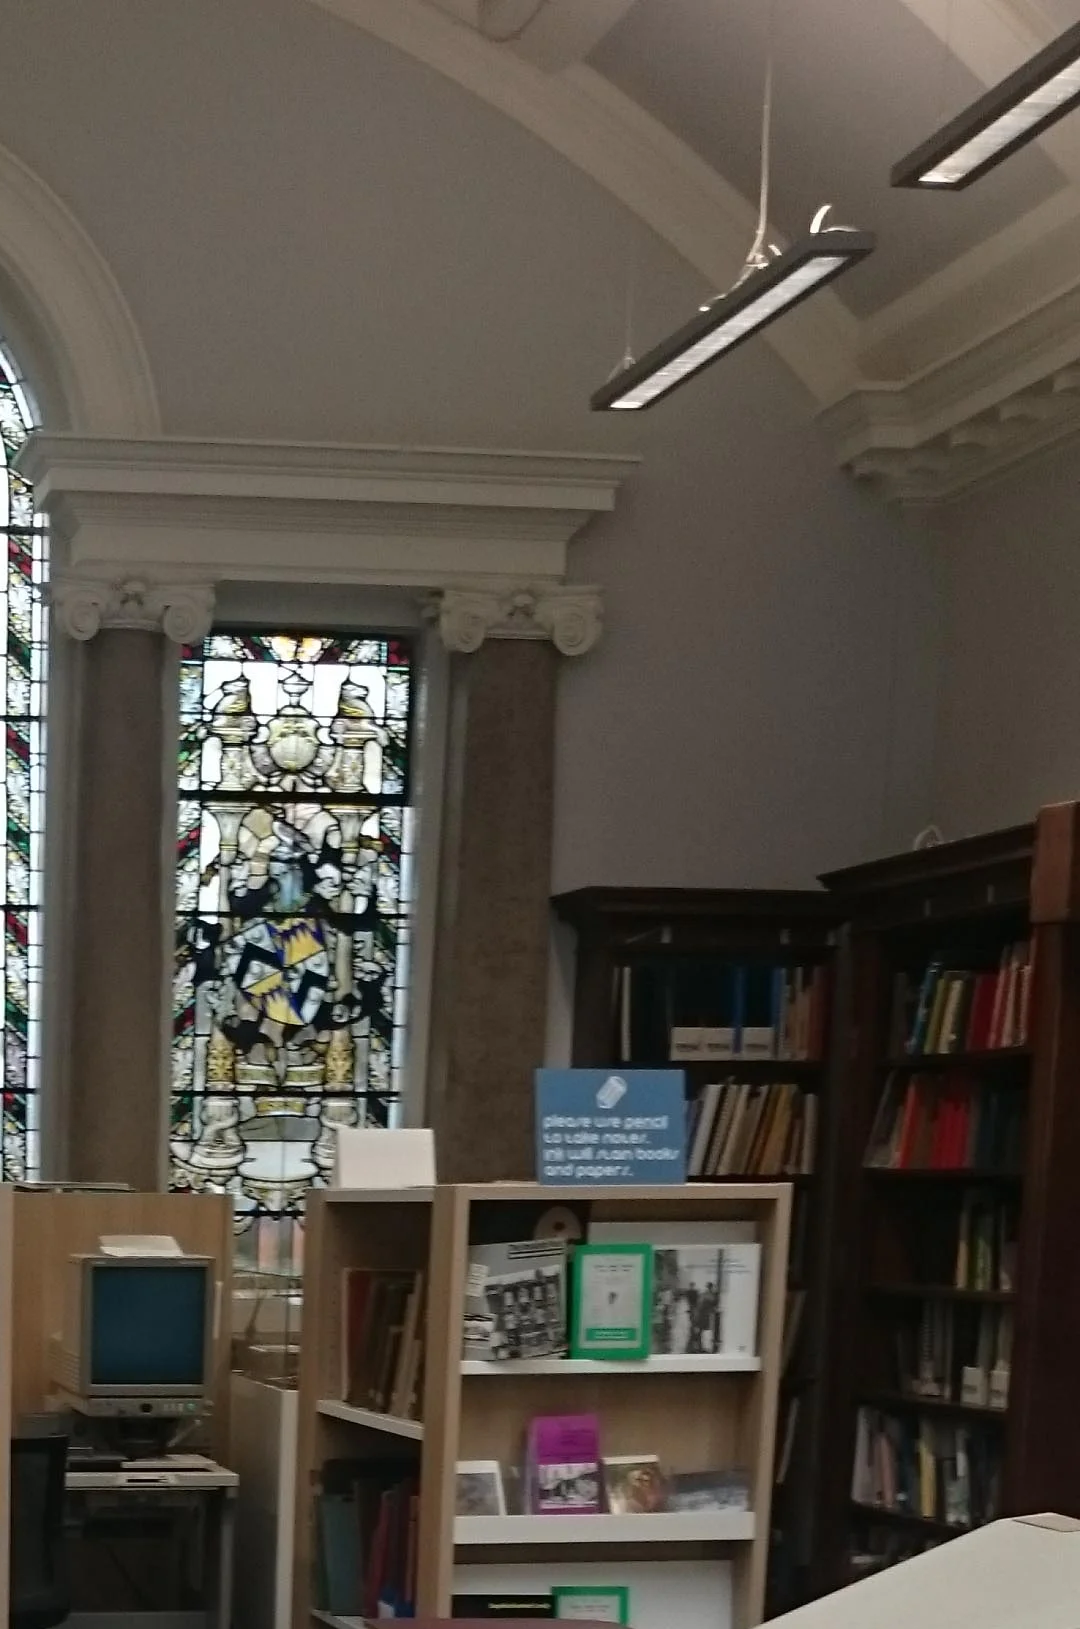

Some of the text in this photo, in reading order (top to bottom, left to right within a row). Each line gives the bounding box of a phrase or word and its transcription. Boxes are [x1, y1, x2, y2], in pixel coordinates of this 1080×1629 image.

[542, 1115, 591, 1129] please
[623, 1115, 668, 1130] pencil
[542, 1132, 562, 1144] to
[544, 1164, 573, 1177] and
